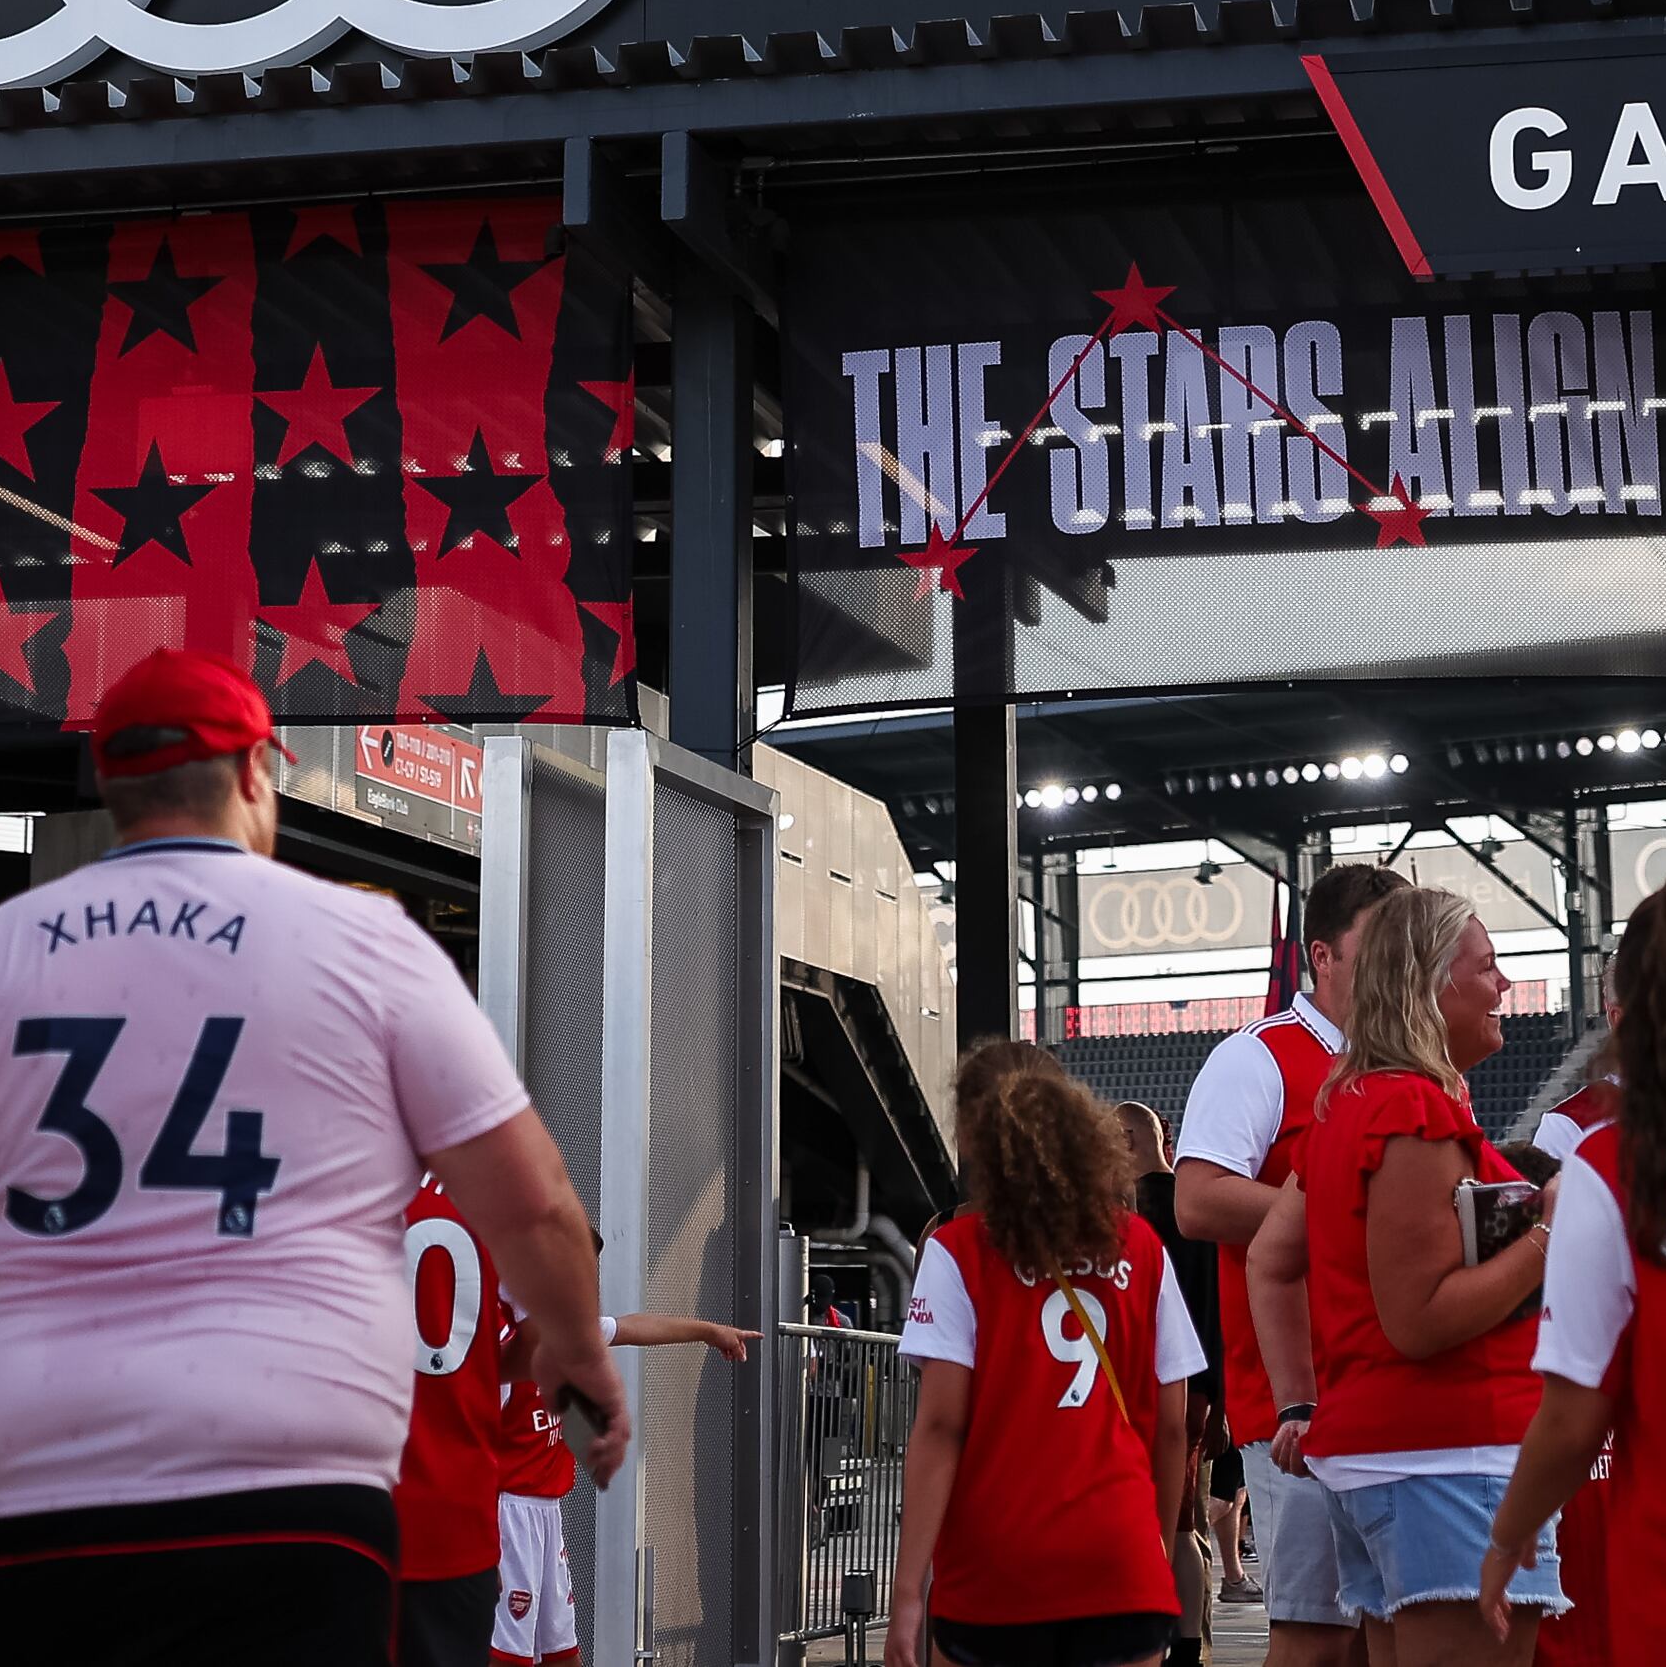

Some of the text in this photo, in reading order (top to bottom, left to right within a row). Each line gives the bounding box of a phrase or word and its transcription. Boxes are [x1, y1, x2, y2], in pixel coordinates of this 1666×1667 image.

[841, 308, 1664, 549] THE STARS ALIGN
[37, 897, 248, 956] XHAKA
[3, 1015, 282, 1238] 34
[1042, 1287, 1107, 1408] 9
